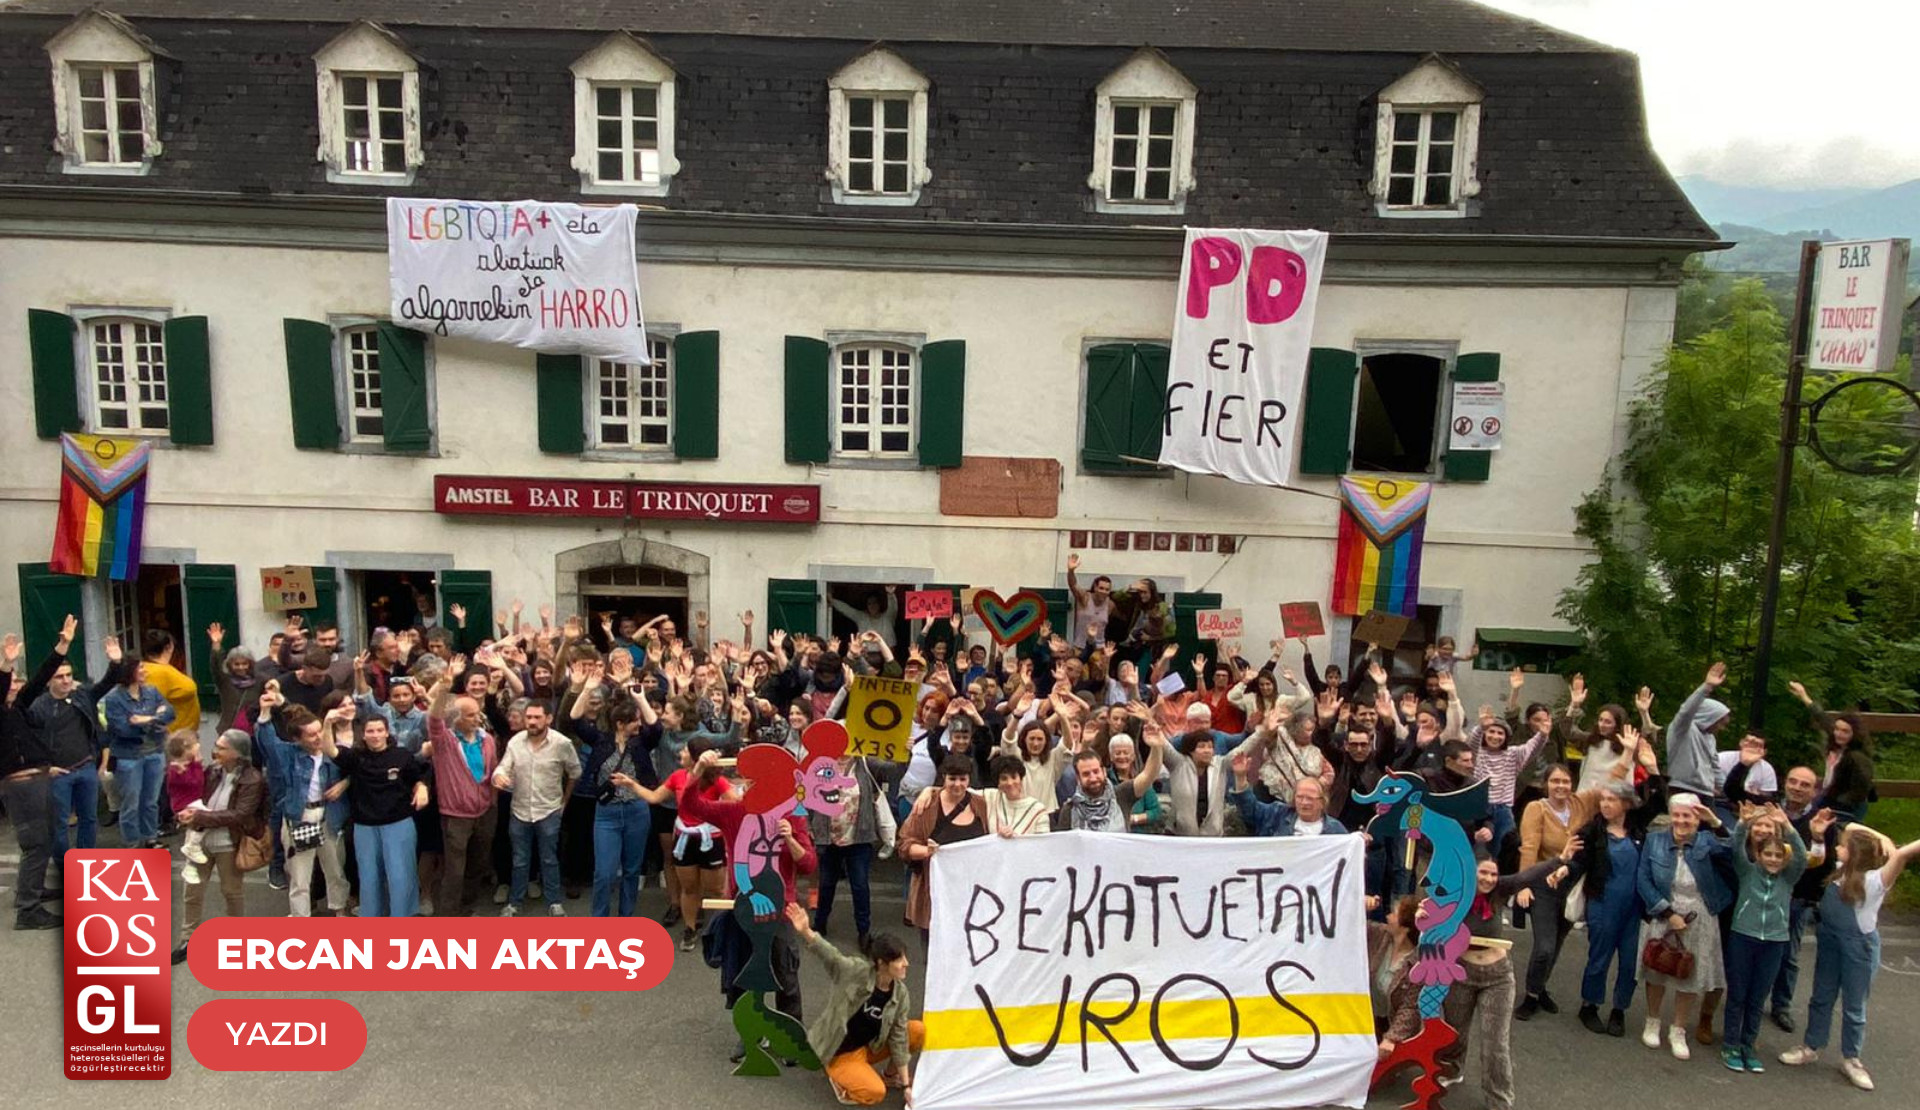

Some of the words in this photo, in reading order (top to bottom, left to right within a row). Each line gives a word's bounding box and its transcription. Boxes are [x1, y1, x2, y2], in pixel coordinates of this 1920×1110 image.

[408, 204, 551, 242] LGBTQIA+
[566, 212, 601, 235] eta
[1838, 245, 1871, 269] BAR
[519, 274, 545, 298] eta
[1186, 237, 1307, 324] PD
[1846, 276, 1859, 298] LE
[400, 284, 532, 336] algarrekin
[1820, 306, 1877, 332] TRINQUET
[1207, 338, 1254, 374] ET
[1164, 382, 1287, 448] FIER
[444, 486, 513, 505] AMSTEL
[528, 487, 581, 508] BAR
[592, 489, 625, 510] LE
[637, 490, 774, 517] TRINQUET
[857, 676, 913, 696] INTER
[964, 858, 1346, 967] BEKATUETAN
